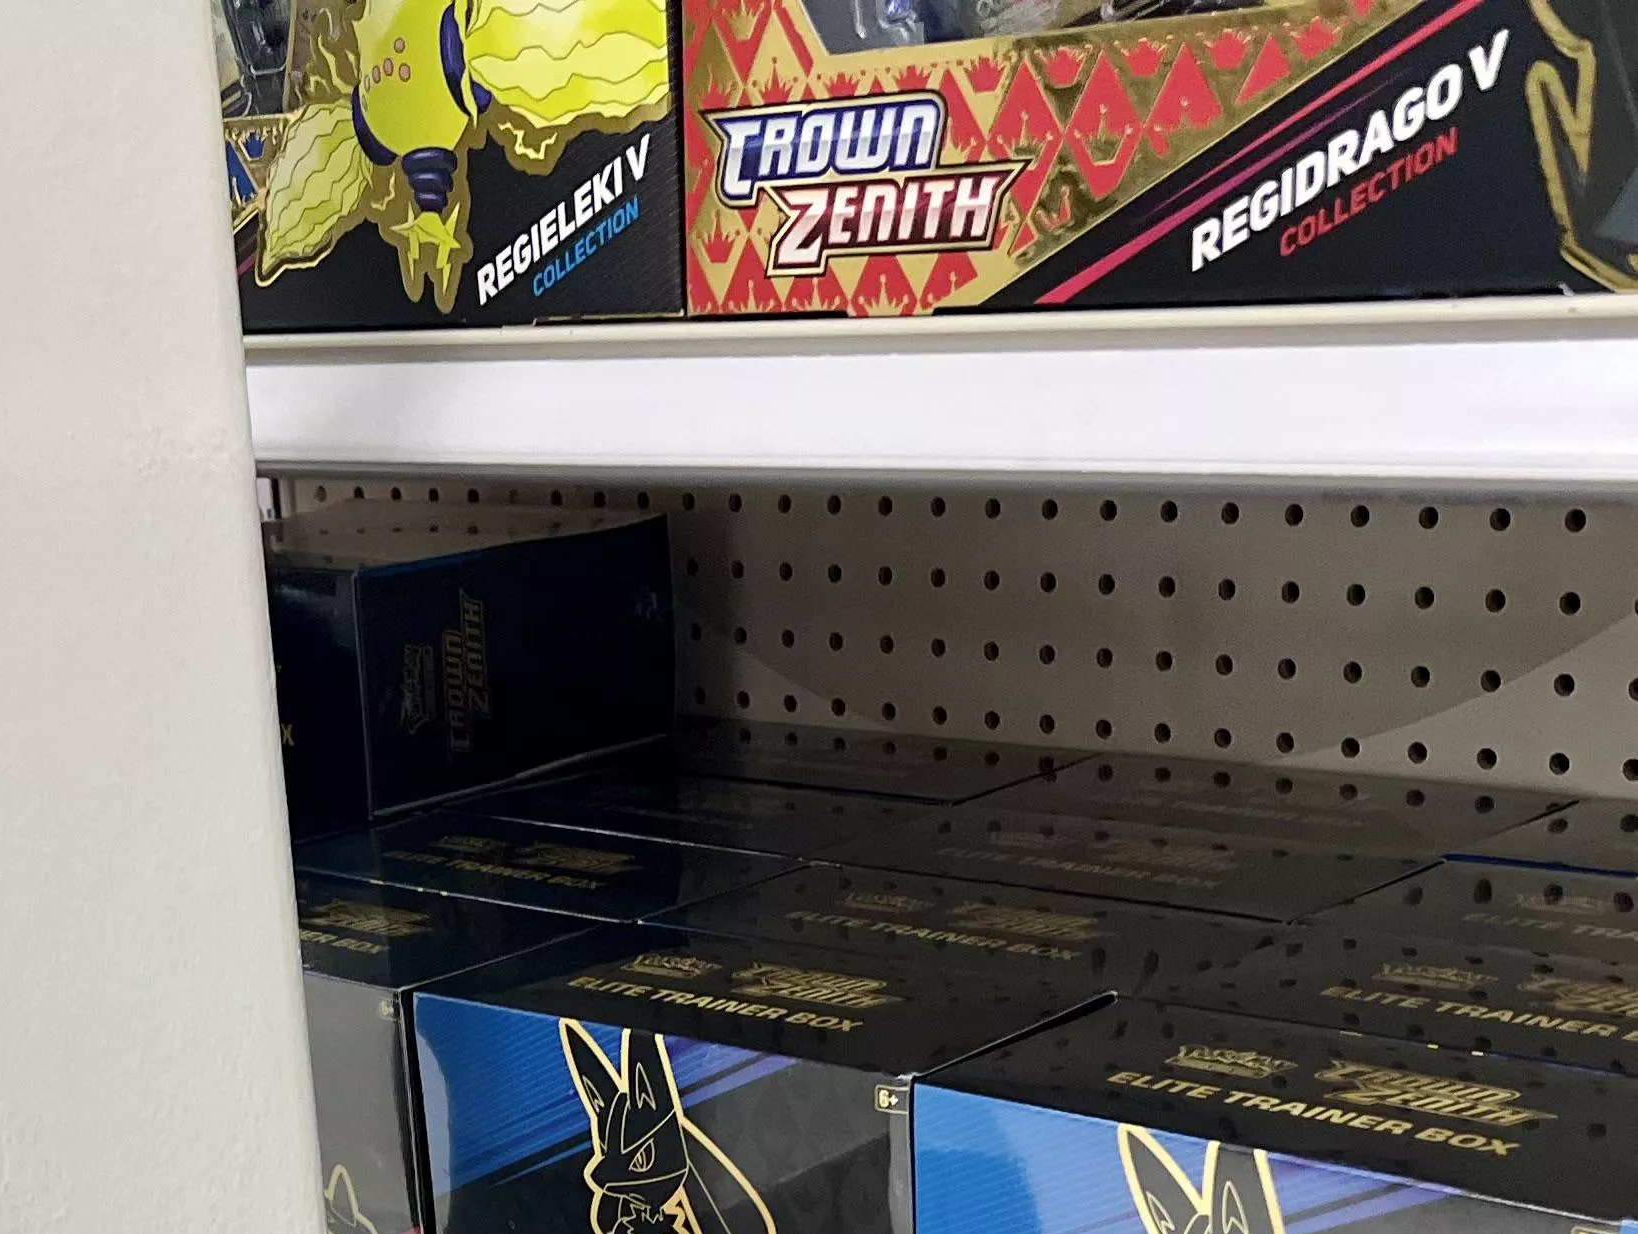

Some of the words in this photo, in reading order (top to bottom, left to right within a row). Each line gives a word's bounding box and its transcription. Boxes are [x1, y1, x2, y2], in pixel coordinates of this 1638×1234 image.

[720, 100, 939, 197] CROWN
[1191, 66, 1464, 272] REGIDRAGO
[1466, 29, 1511, 91] V
[1280, 127, 1460, 257] COLLECTION
[475, 165, 622, 304] REGIELEKI
[623, 135, 652, 183] V
[532, 198, 640, 297] COLLECTION
[774, 174, 1001, 268] ZENITH
[567, 975, 652, 999] ELITE
[651, 988, 788, 1019] TRAINER
[785, 1011, 865, 1032] BOX
[1320, 985, 1432, 1009] ELITE
[1434, 1002, 1620, 1037] TRAINER
[878, 1090, 899, 1108] 6+
[1107, 1070, 1222, 1098] ELITE
[1222, 1090, 1415, 1135] TRAINER
[1414, 1127, 1520, 1157] BOX
